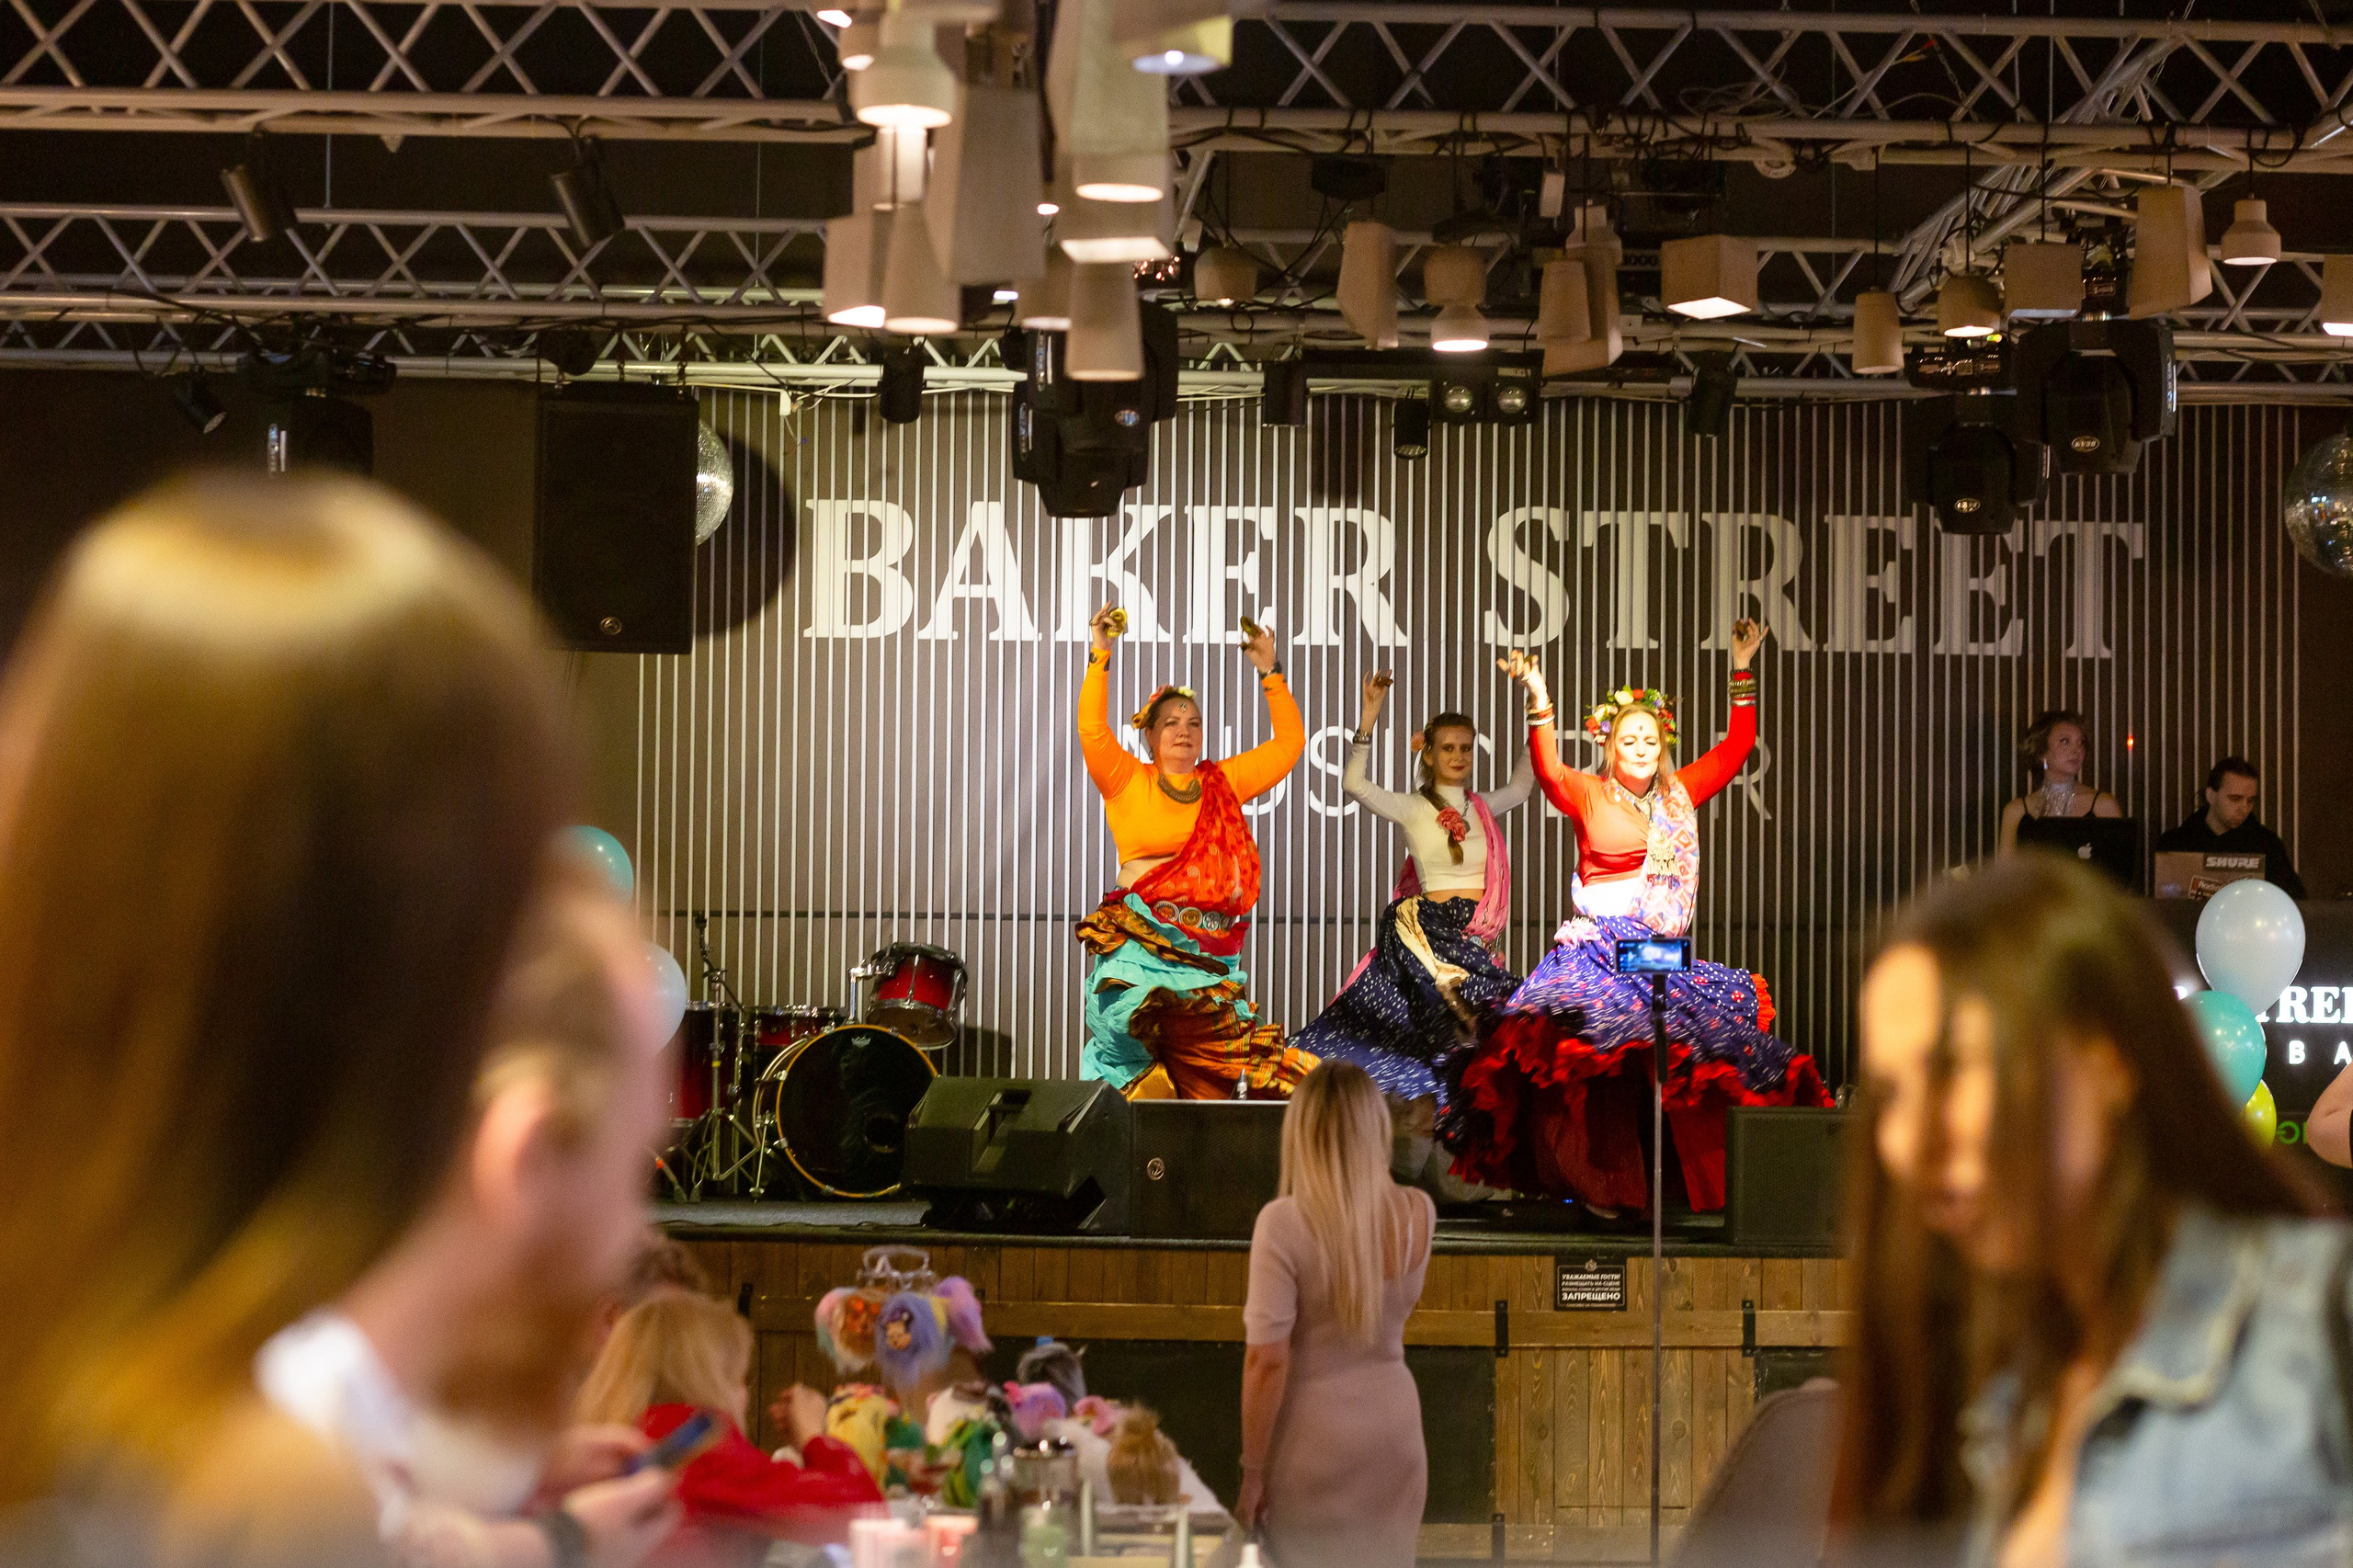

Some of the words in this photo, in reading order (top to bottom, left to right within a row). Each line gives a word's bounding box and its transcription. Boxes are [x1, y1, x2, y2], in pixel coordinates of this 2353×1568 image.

[804, 498, 1408, 647] BAKER
[1483, 506, 2143, 658] STREET
[2205, 856, 2260, 869] SHURE
[1562, 1291, 1621, 1301] ЗАПРЕЩЕНО
